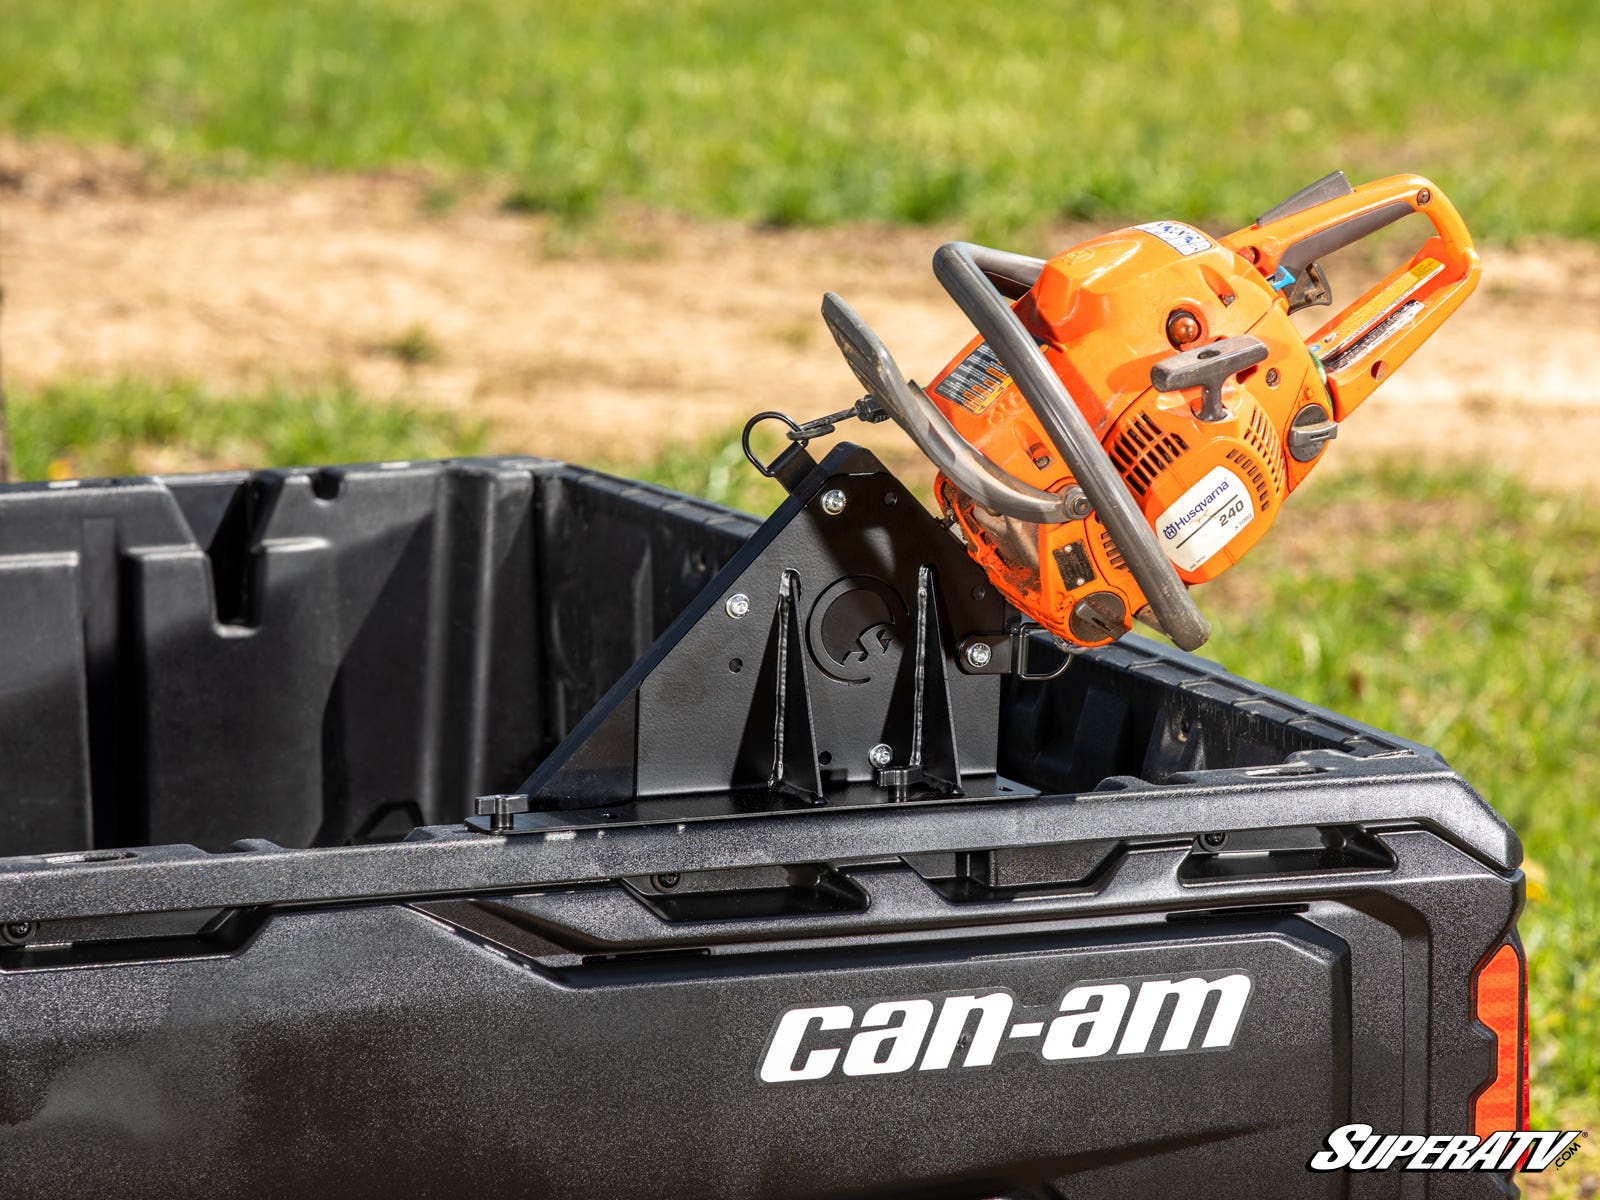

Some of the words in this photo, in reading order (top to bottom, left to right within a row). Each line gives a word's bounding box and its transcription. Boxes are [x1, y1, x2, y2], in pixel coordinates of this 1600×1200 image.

[1174, 481, 1229, 530] Husqvarna
[1219, 500, 1244, 527] 240
[760, 974, 1252, 1083] can-am
